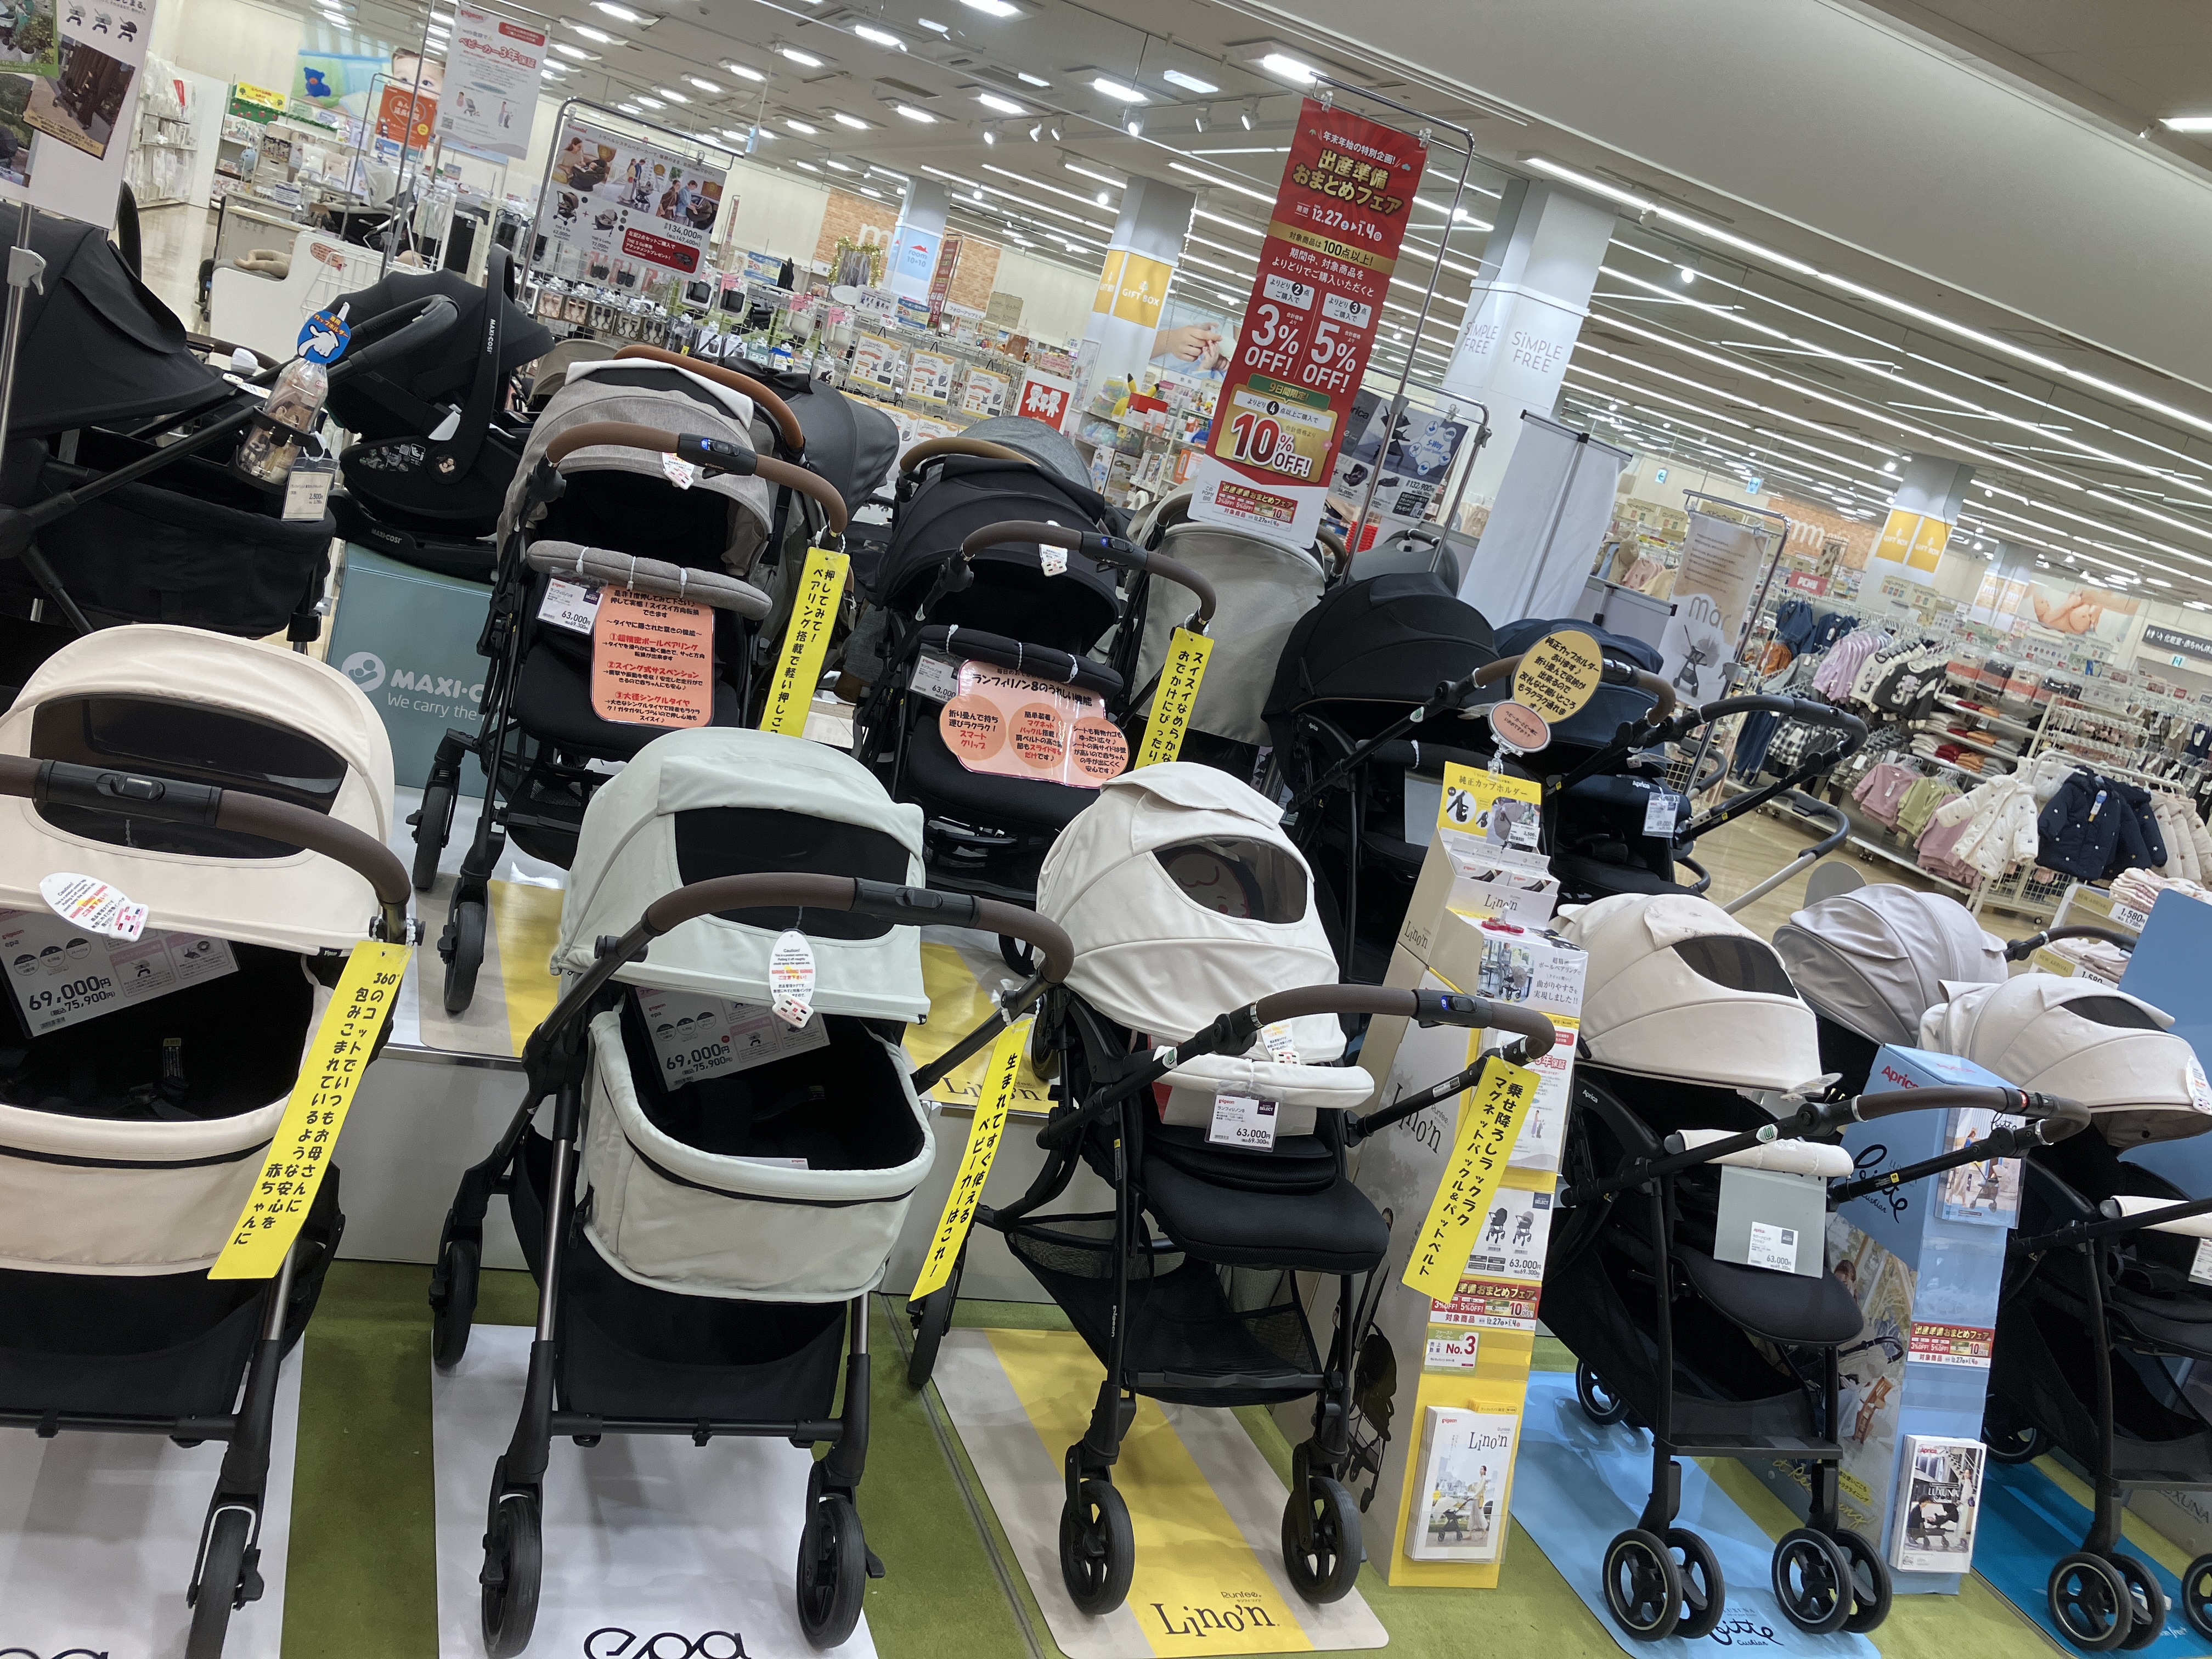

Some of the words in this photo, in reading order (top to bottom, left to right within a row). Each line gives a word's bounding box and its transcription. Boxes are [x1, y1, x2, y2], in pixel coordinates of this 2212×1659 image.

[1323, 131, 1396, 165] 年末年始の特別企画!
[1318, 149, 1389, 190] 出産準備
[1293, 164, 1404, 215] おまとめフェア
[668, 223, 703, 241] 134,000円
[909, 251, 927, 260] room
[1289, 247, 1364, 280] 期間中、対象商品を
[1272, 256, 1375, 297] よりどりでご購入いただくと
[1122, 288, 1141, 301] GIFT
[1142, 295, 1160, 307] BOX
[1276, 291, 1300, 304] ご購入で
[313, 313, 349, 338] カップホルダー
[330, 314, 341, 326] 専用
[1334, 309, 1357, 323] ご購入で
[1252, 304, 1299, 355] 3%
[1311, 320, 1356, 372] 5%
[1463, 338, 1489, 354] FREE
[1245, 346, 1293, 376] OFF!
[1513, 349, 1552, 373] FREE
[1302, 364, 1350, 393] OFF!
[1268, 383, 1310, 402] 9日間限定!
[1272, 453, 1313, 478] OFF!
[1222, 482, 1294, 508] 出産準備おまとめフェア
[643, 609, 668, 618] できます
[810, 569, 836, 642] 押してみて!
[561, 610, 591, 626] 63,000円
[635, 652, 674, 661] 転換が出来ます
[1544, 636, 1600, 673] 純正カップホルダー
[1534, 656, 1586, 690] 折り畳んで収納が
[1537, 670, 1572, 694] 出来るので
[973, 674, 1092, 707] ランフィリノン8のうれしい機能
[1517, 683, 1567, 715] もラクラク通れま
[1519, 671, 1577, 710] 改札など細いところ
[388, 692, 409, 709] We
[413, 699, 450, 718] carry
[453, 706, 477, 721] the
[949, 709, 998, 724] 折り畳んで持ち
[1146, 651, 1190, 766] おでかけにぴったり
[1161, 652, 1204, 763] スイスイなめらかな
[949, 719, 996, 732] 運びラクラク!
[1027, 720, 1054, 729] マグネット
[960, 730, 986, 740] スマート
[961, 739, 986, 749] グリップ
[1017, 742, 1062, 755] 節もスライドする
[1074, 749, 1125, 761] が高いので赤ちゃん
[1080, 758, 1120, 768] の手が出にくく
[1459, 775, 1528, 796] 純正カップホルダー
[1632, 780, 1651, 789] Aprica
[2121, 907, 2146, 924] 1,580円
[5, 939, 19, 948] epa
[1404, 921, 1429, 950] Lino'n
[2039, 953, 2050, 963] NEW
[2050, 960, 2069, 973] ARRIVAL
[29, 976, 112, 1011] 69,000円
[1536, 980, 1578, 994] 曲がりやすさを
[666, 1043, 730, 1070] 69,000円
[1583, 1089, 1598, 1103] Aprica
[960, 1052, 1018, 1223] 生まれてすぐ使える
[1235, 1127, 1271, 1141] 63,000円
[1457, 1082, 1524, 1227] 乗せ降ろしラックラク
[233, 1163, 283, 1246] 赤ちゃんに
[930, 1118, 990, 1278] ベビーカーはこれ!
[1509, 1258, 1542, 1271] 63,000円
[1767, 1255, 1792, 1266] 63,000円
[1111, 1305, 1119, 1338] pigeon
[1445, 1313, 1475, 1323] 対象商品
[1915, 1324, 1991, 1341] 出産準備おまとめフェア
[1919, 1353, 1943, 1362] 対象商品
[1468, 1431, 1508, 1451] Lino'n
[1928, 1487, 1960, 1498] LUXUNA
[1150, 1602, 1278, 1638] Lino'n
